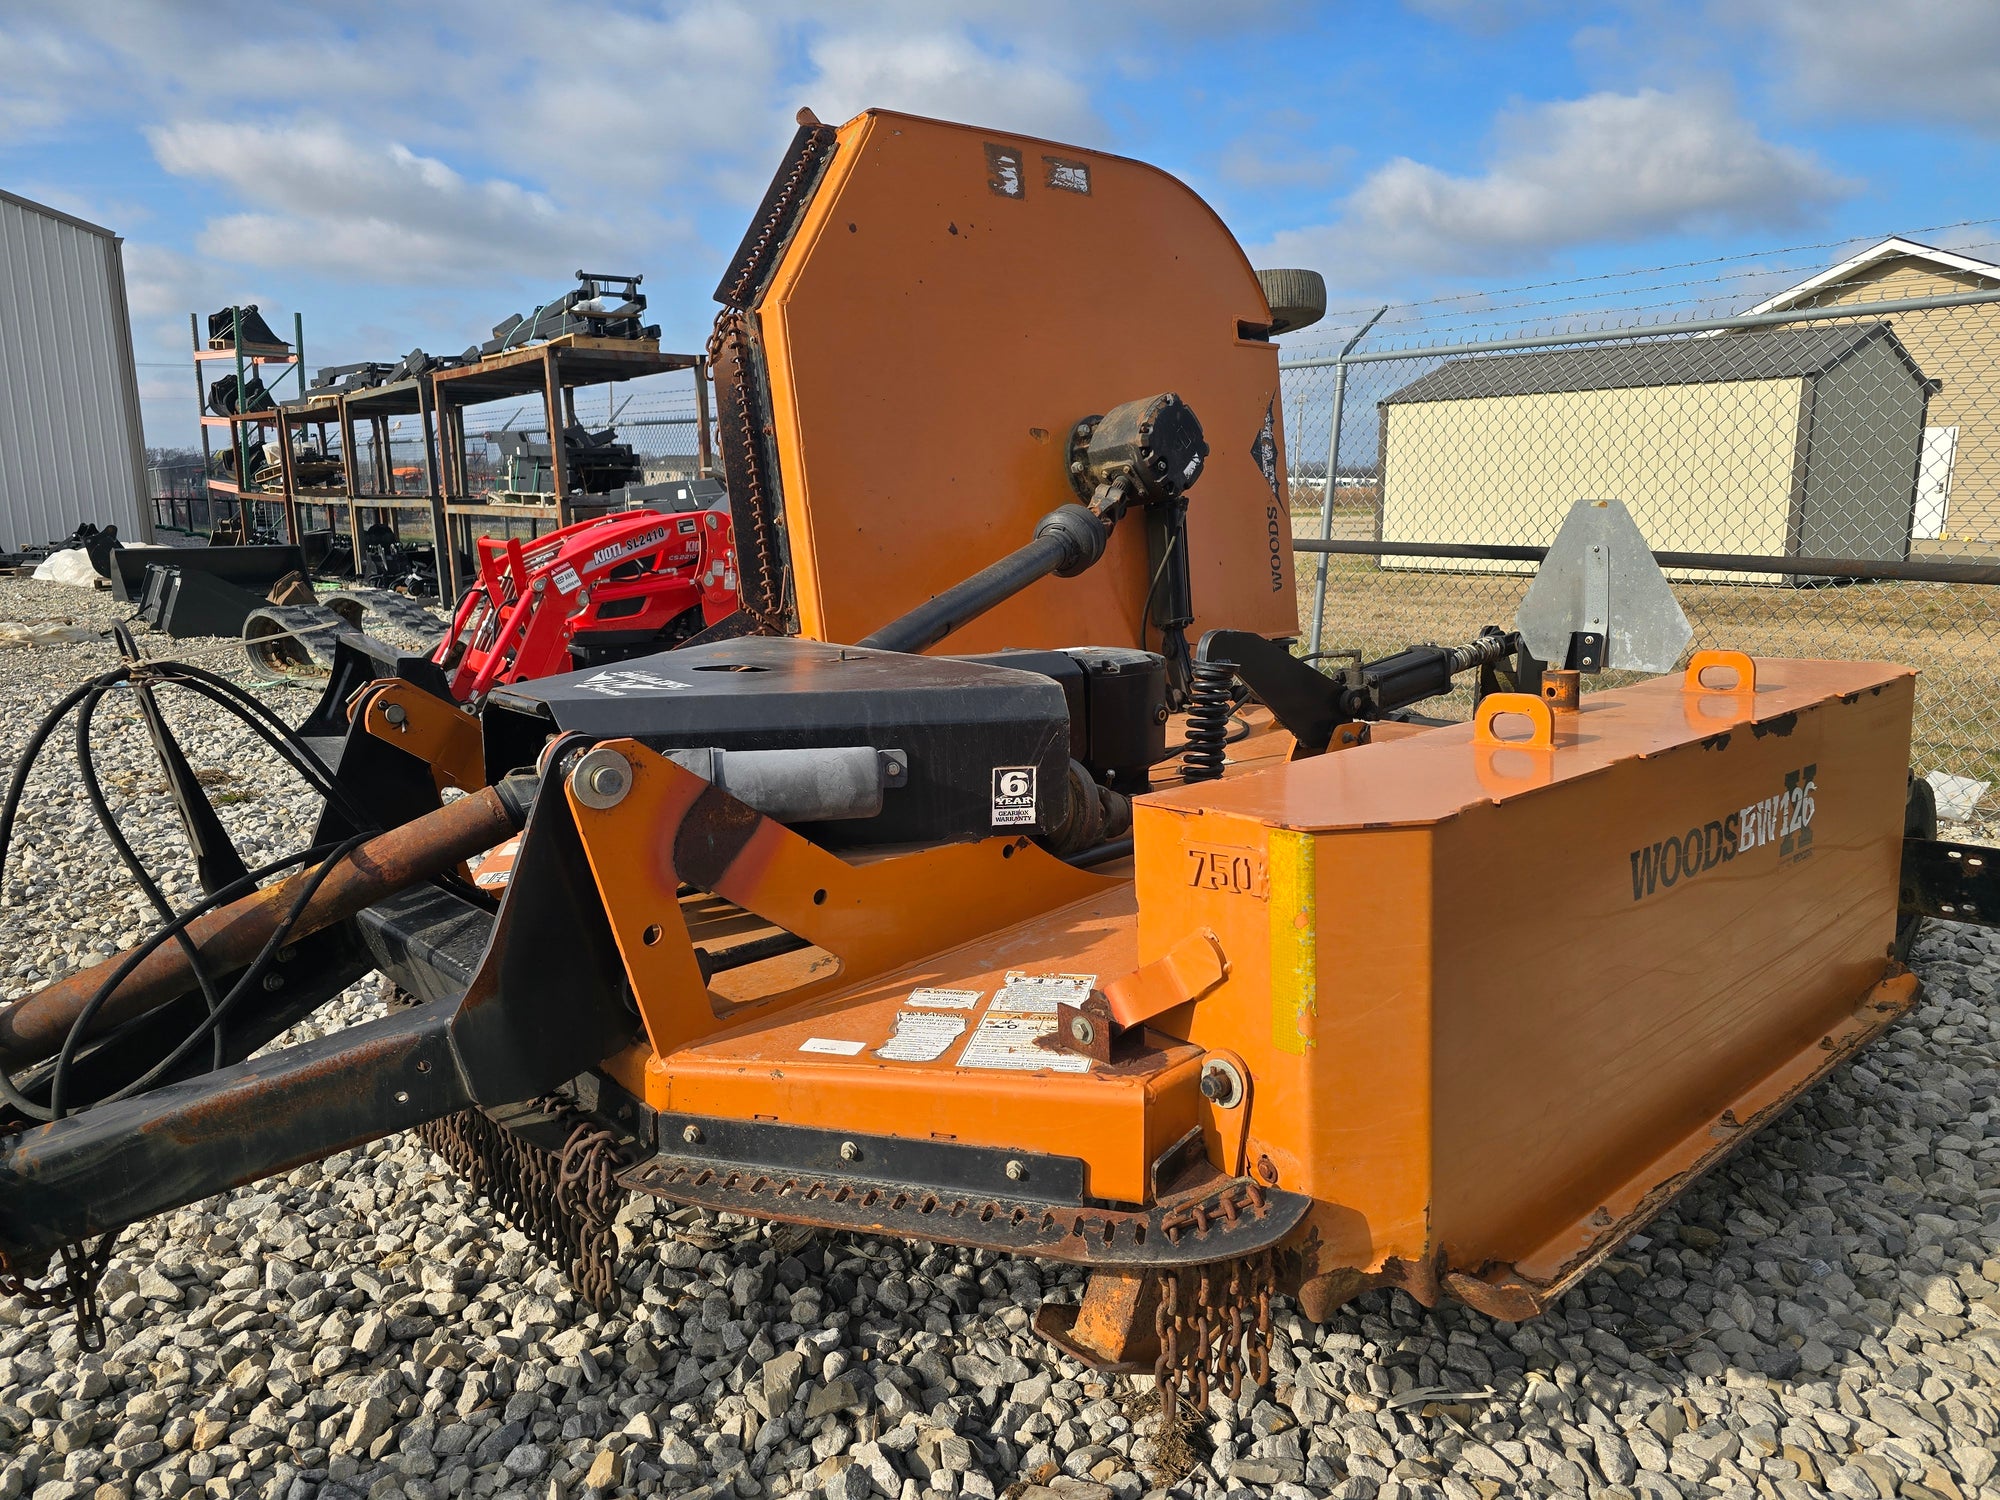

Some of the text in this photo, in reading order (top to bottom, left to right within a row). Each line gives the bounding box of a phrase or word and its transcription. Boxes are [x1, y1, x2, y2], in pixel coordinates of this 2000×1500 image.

[593, 527, 665, 565] KIOTI SL2410
[1267, 507, 1283, 592] WOODS
[995, 797, 1034, 805] YEAR
[1000, 771, 1029, 797] 6
[1630, 812, 1739, 901] WOODS
